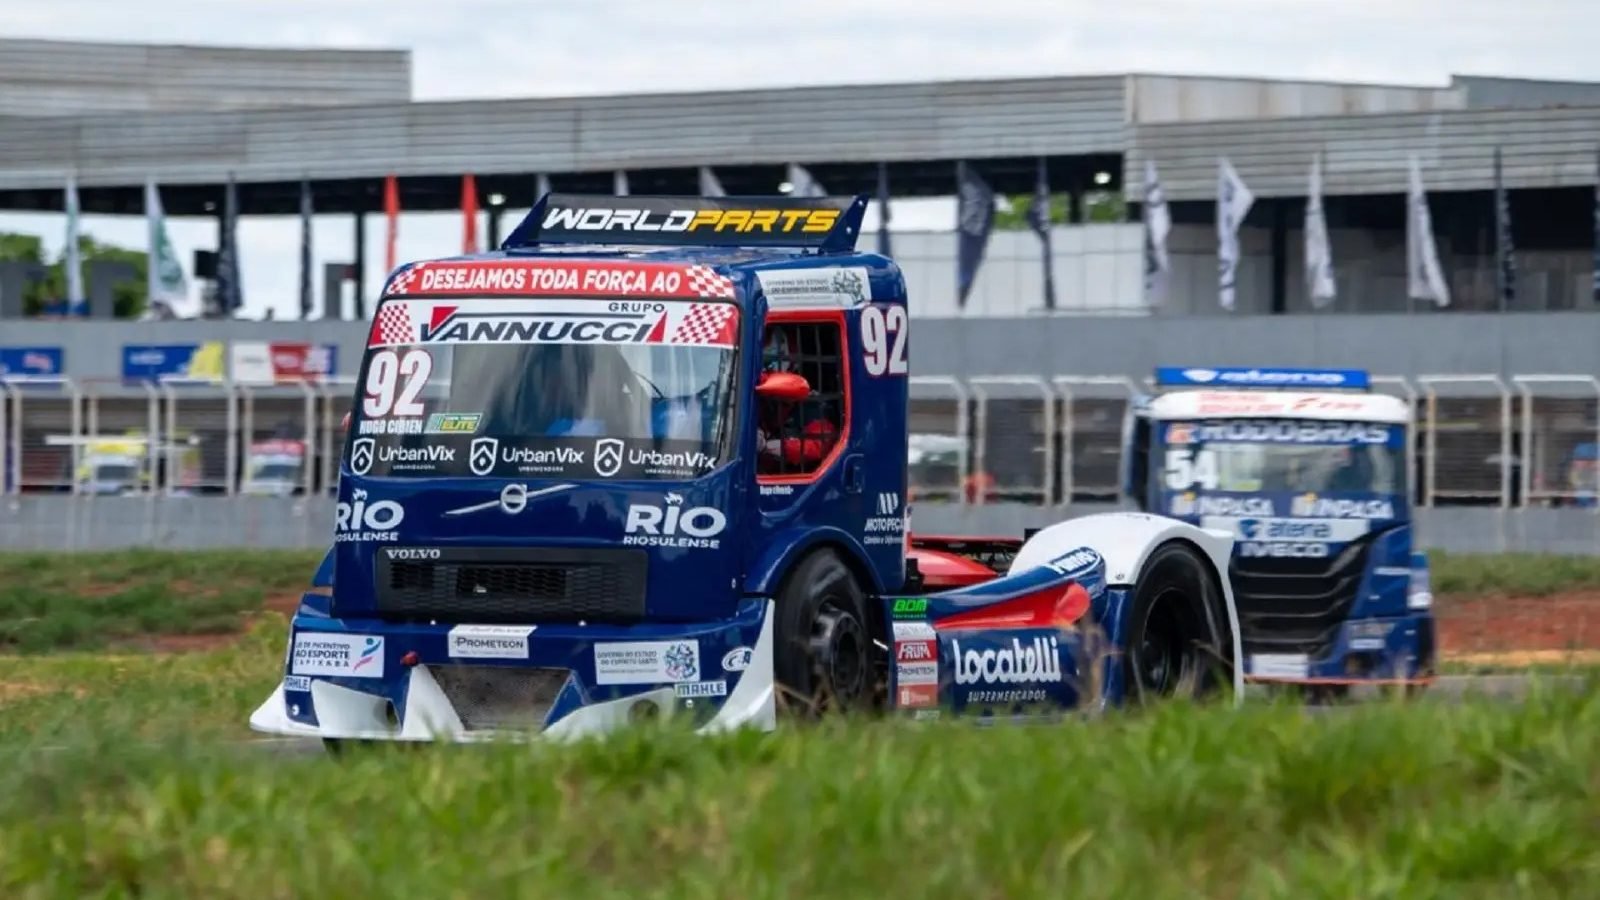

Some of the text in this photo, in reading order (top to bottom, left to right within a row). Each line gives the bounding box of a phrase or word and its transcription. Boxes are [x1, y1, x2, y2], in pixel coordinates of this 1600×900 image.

[542, 208, 840, 232] WORLDPARTS
[421, 268, 681, 294] DESEJAMOS TODA FORÇA AO
[608, 302, 664, 313] GRUPO
[420, 312, 654, 342] VANNUCCI
[861, 305, 908, 376] 92
[363, 349, 432, 418] 92
[359, 419, 387, 434] HUGO
[441, 420, 476, 431] ELITE
[1200, 420, 1390, 444] RODOBRAS
[379, 445, 456, 462] UrbanVix
[502, 447, 585, 464] UrbanVix
[628, 449, 717, 470] UrbanVix
[1165, 449, 1218, 490] 54
[335, 489, 405, 531] RIO
[625, 492, 727, 538] RIO
[623, 535, 721, 549] RIOSULENSE
[1239, 542, 1329, 557] IVECO
[386, 548, 441, 560] VOLVO
[312, 642, 351, 650] INCENTIVO
[456, 637, 524, 649] PROMETEON
[295, 649, 350, 659] AO ESPORTE
[952, 636, 1062, 684] Locatelli
[294, 660, 350, 668] CAPIXABA
[677, 683, 724, 695] MAHLE
[967, 689, 1048, 703] SUPERMERCADOS
